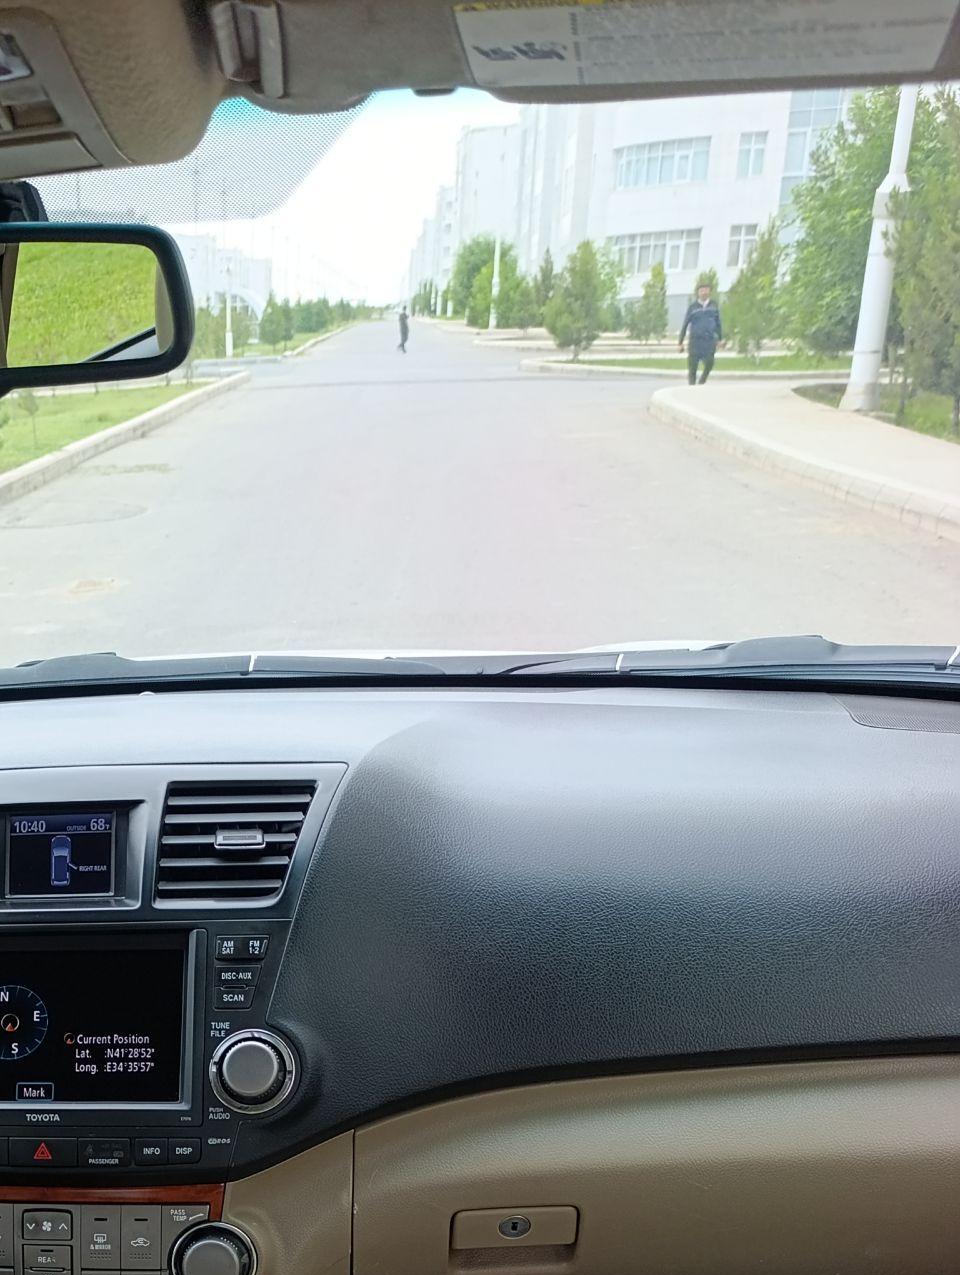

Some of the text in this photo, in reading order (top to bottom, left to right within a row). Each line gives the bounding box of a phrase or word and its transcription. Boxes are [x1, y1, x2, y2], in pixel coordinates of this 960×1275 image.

[14, 821, 46, 833] 10:40
[0, 991, 9, 1002] N
[33, 1010, 40, 1022] E
[76, 1034, 150, 1044] Current Position
[11, 1042, 19, 1054] S
[75, 1048, 92, 1058] Lat.
[75, 1062, 99, 1074] Long.
[23, 1087, 45, 1098] Mark
[25, 1114, 60, 1122] TOYOTA
[208, 1112, 230, 1120] AUDIO
[143, 1147, 161, 1155] INFO
[175, 1147, 193, 1155] DISP
